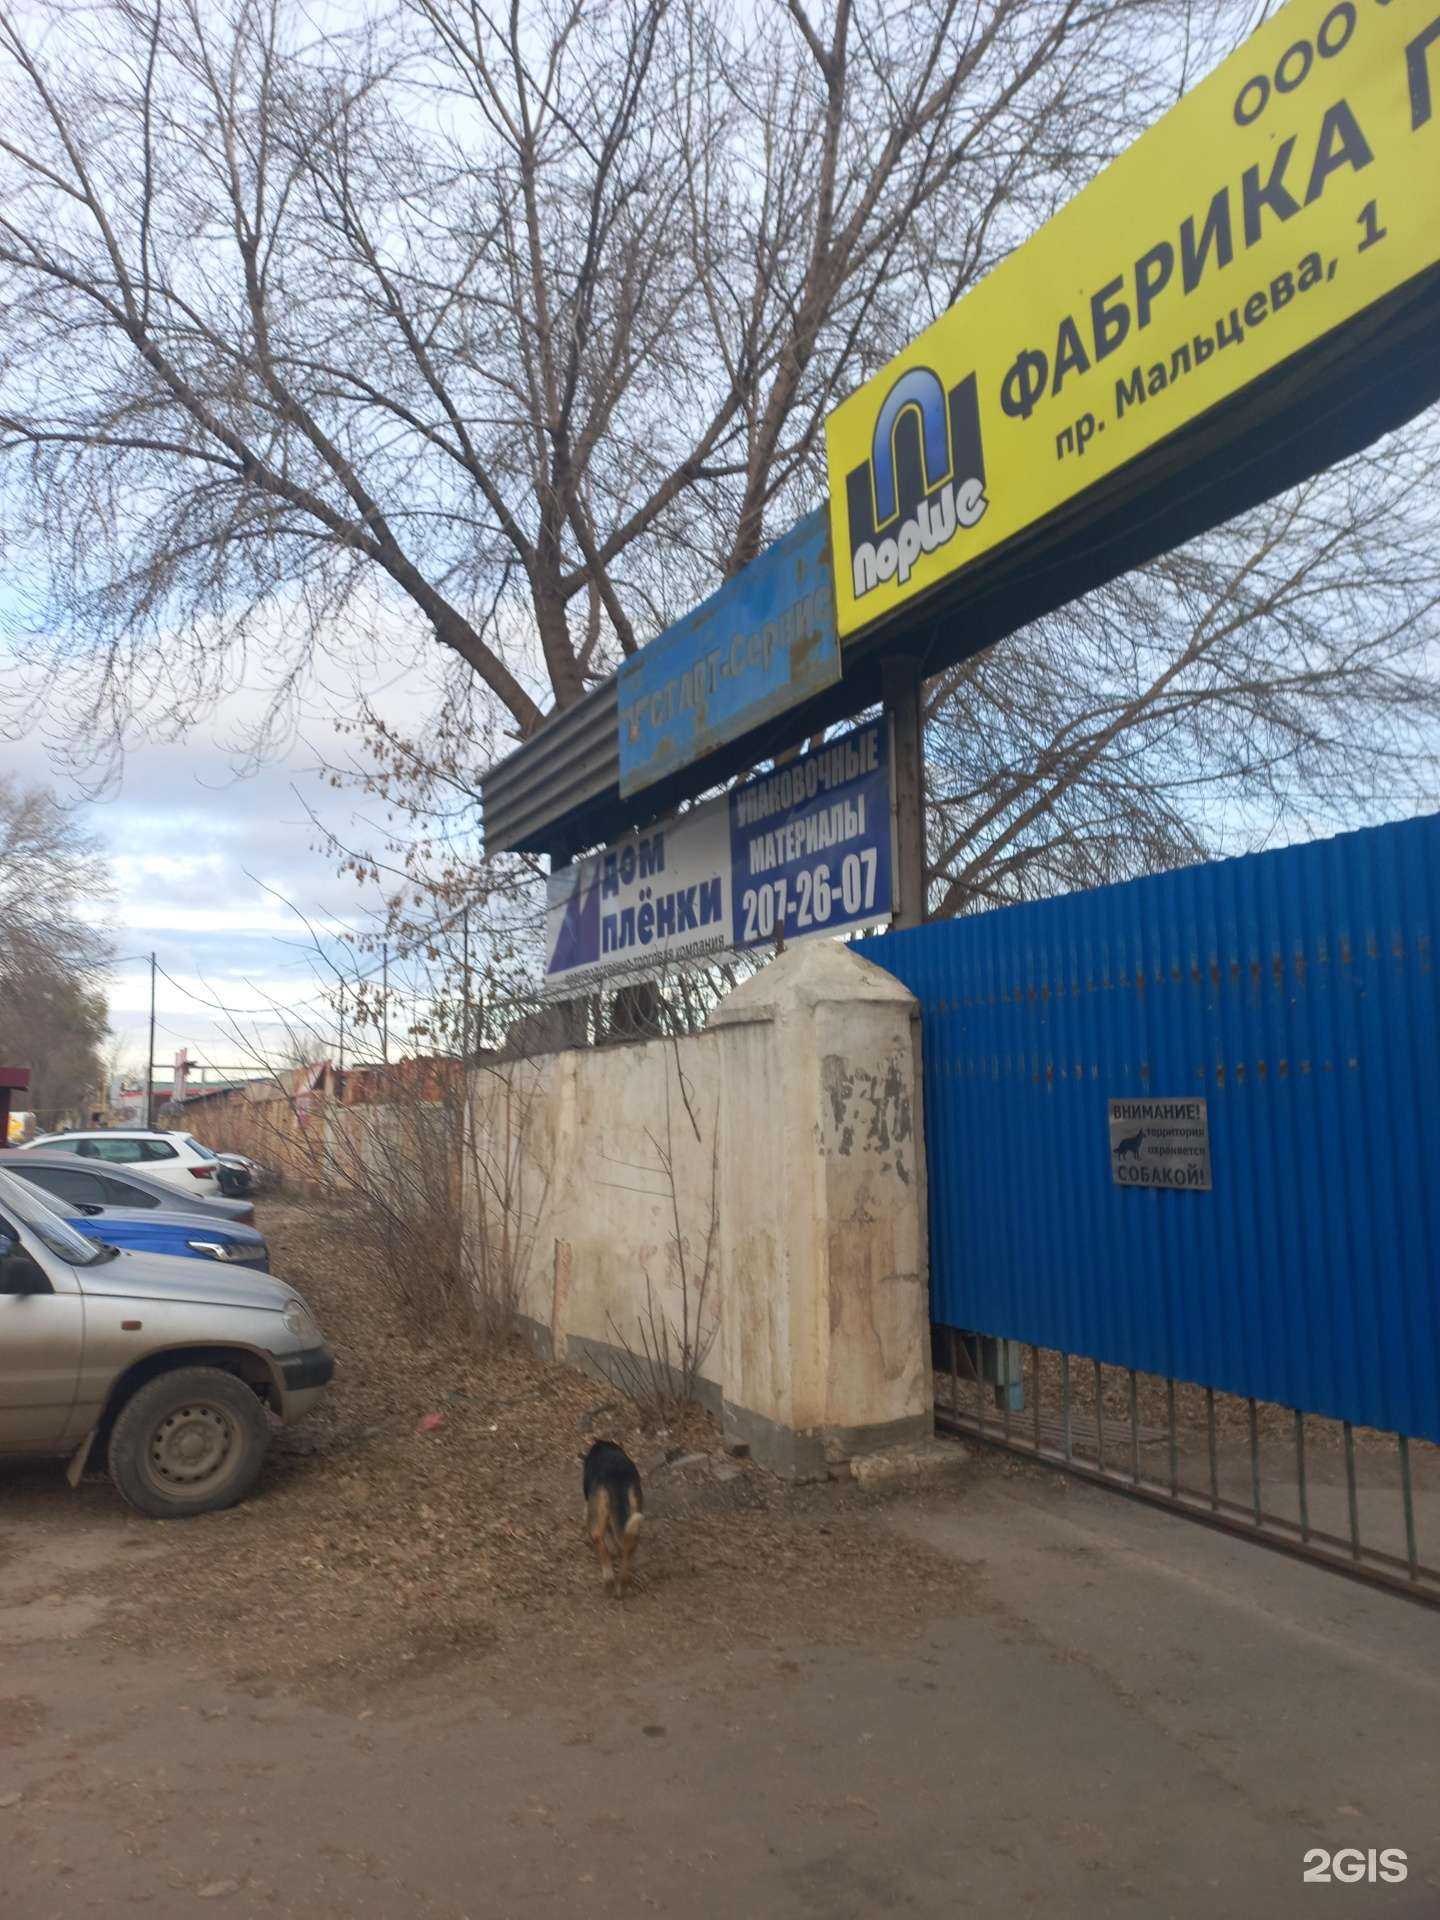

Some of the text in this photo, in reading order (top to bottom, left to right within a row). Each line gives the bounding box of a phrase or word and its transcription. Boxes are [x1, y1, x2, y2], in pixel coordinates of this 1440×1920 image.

[1233, 2, 1357, 127] ООО
[1000, 98, 1374, 420] ФАБРИКА
[1055, 199, 1388, 460] пр. Мальцева, 1
[736, 728, 879, 829] УПАКОВОЧНЫЕ
[750, 793, 866, 875] МАТЕРИАЛЫ
[742, 847, 878, 942] 207-26-07
[1113, 1104, 1200, 1120] ВНИМАНИЕ!
[1117, 1163, 1204, 1186] СОБАКОЙ!
